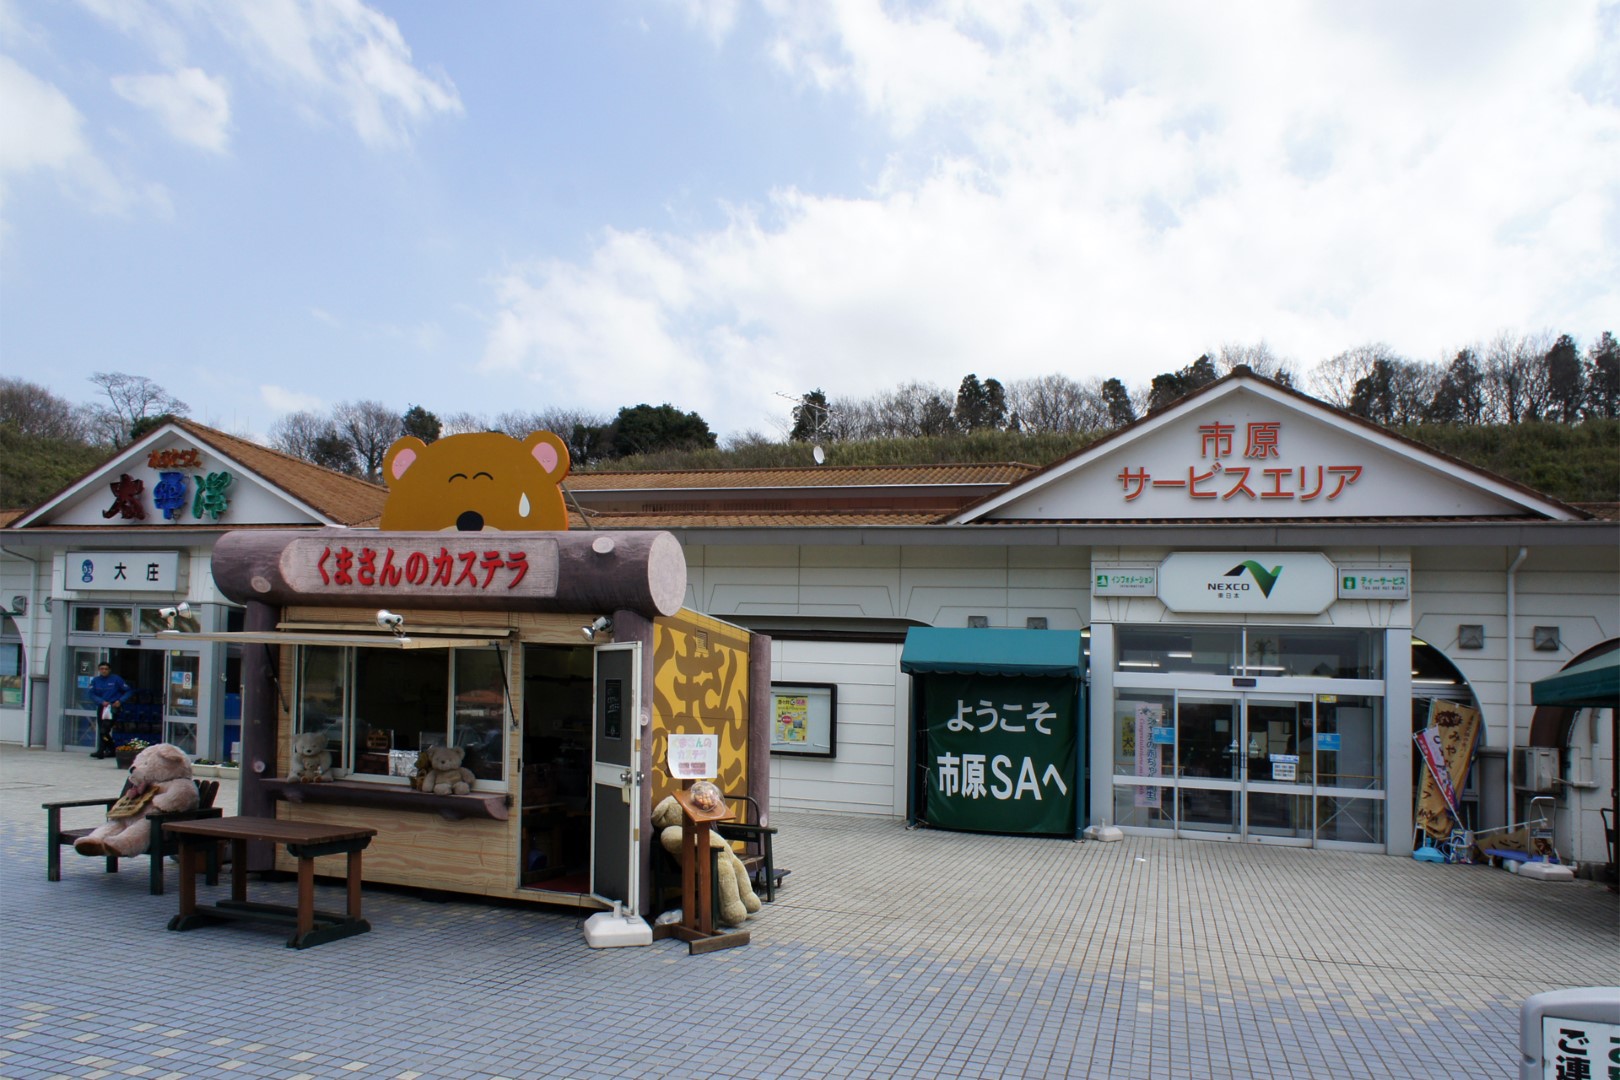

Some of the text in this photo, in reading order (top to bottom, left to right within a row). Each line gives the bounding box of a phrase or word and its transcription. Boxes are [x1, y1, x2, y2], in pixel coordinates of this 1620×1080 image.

[1199, 421, 1281, 458] 市原
[1118, 462, 1364, 501] サービスエリア
[114, 562, 159, 581] 大庄
[317, 546, 529, 590] くまさんのカステラ
[1111, 575, 1154, 584] インフォメーション
[1361, 576, 1406, 585] ティーサービス
[1207, 583, 1250, 591] NEXCO
[947, 700, 1057, 735] ようこそ
[937, 752, 1068, 801] 市原SAへ
